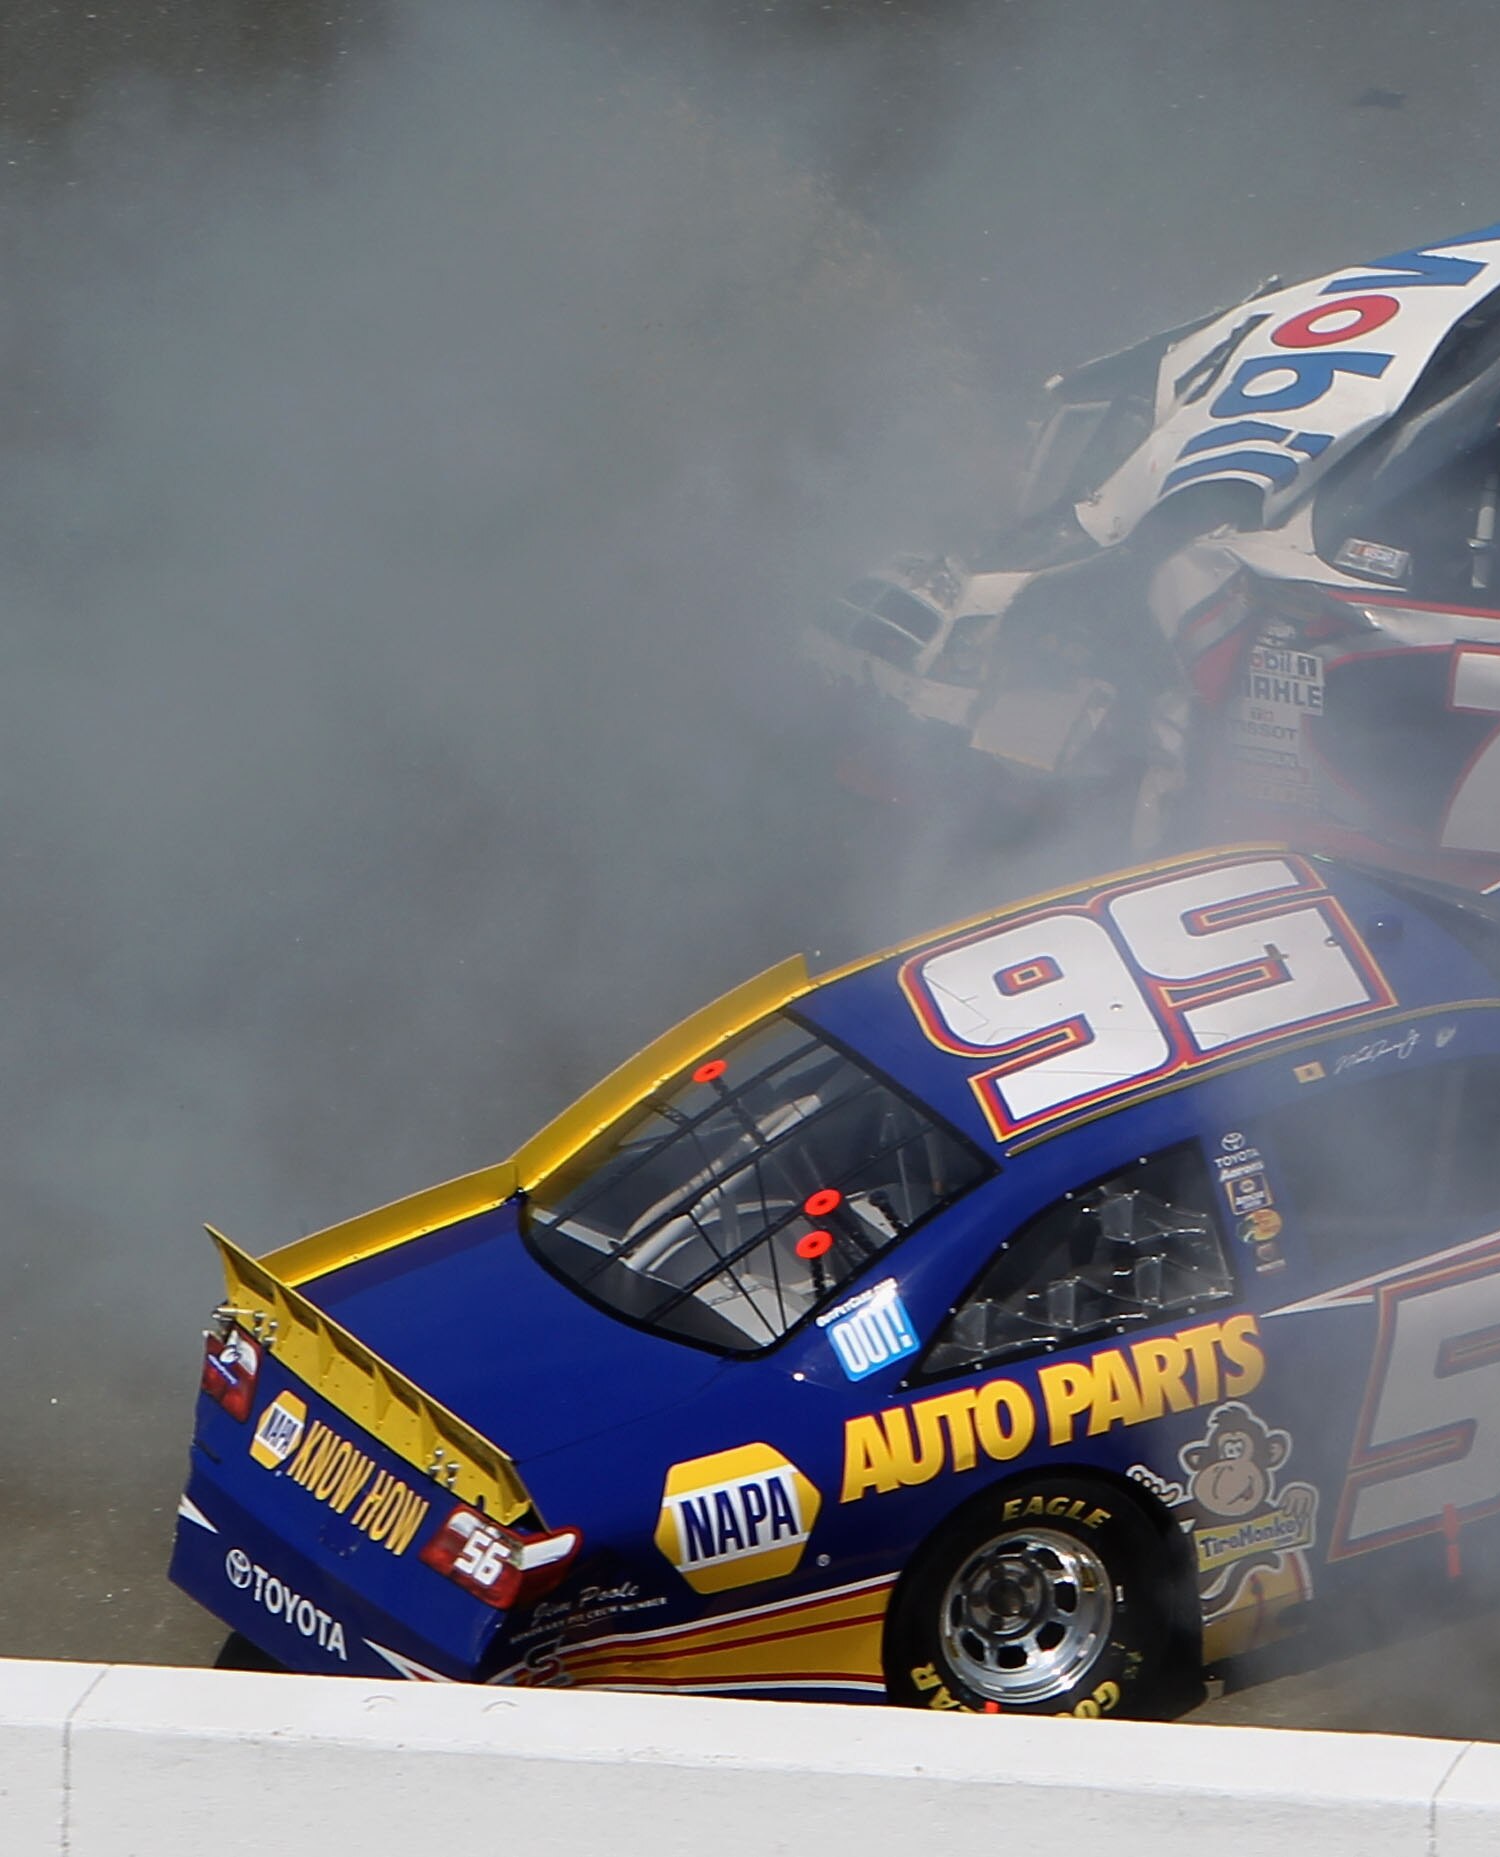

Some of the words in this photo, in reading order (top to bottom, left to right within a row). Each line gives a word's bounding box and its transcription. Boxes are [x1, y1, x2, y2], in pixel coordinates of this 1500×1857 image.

[1214, 1148, 1260, 1168] TOYOTA
[831, 1300, 914, 1373] OUT!
[260, 1406, 300, 1456] NAPA
[840, 1379, 1036, 1504] AUTO
[1037, 1314, 1266, 1449] PARTS
[287, 1419, 377, 1515] KNOW
[350, 1469, 431, 1557] HOW
[682, 1474, 799, 1562] NAPA
[1002, 1496, 1113, 1530] EAGLE
[453, 1529, 512, 1587] 56
[249, 1564, 348, 1662] TOYOTA
